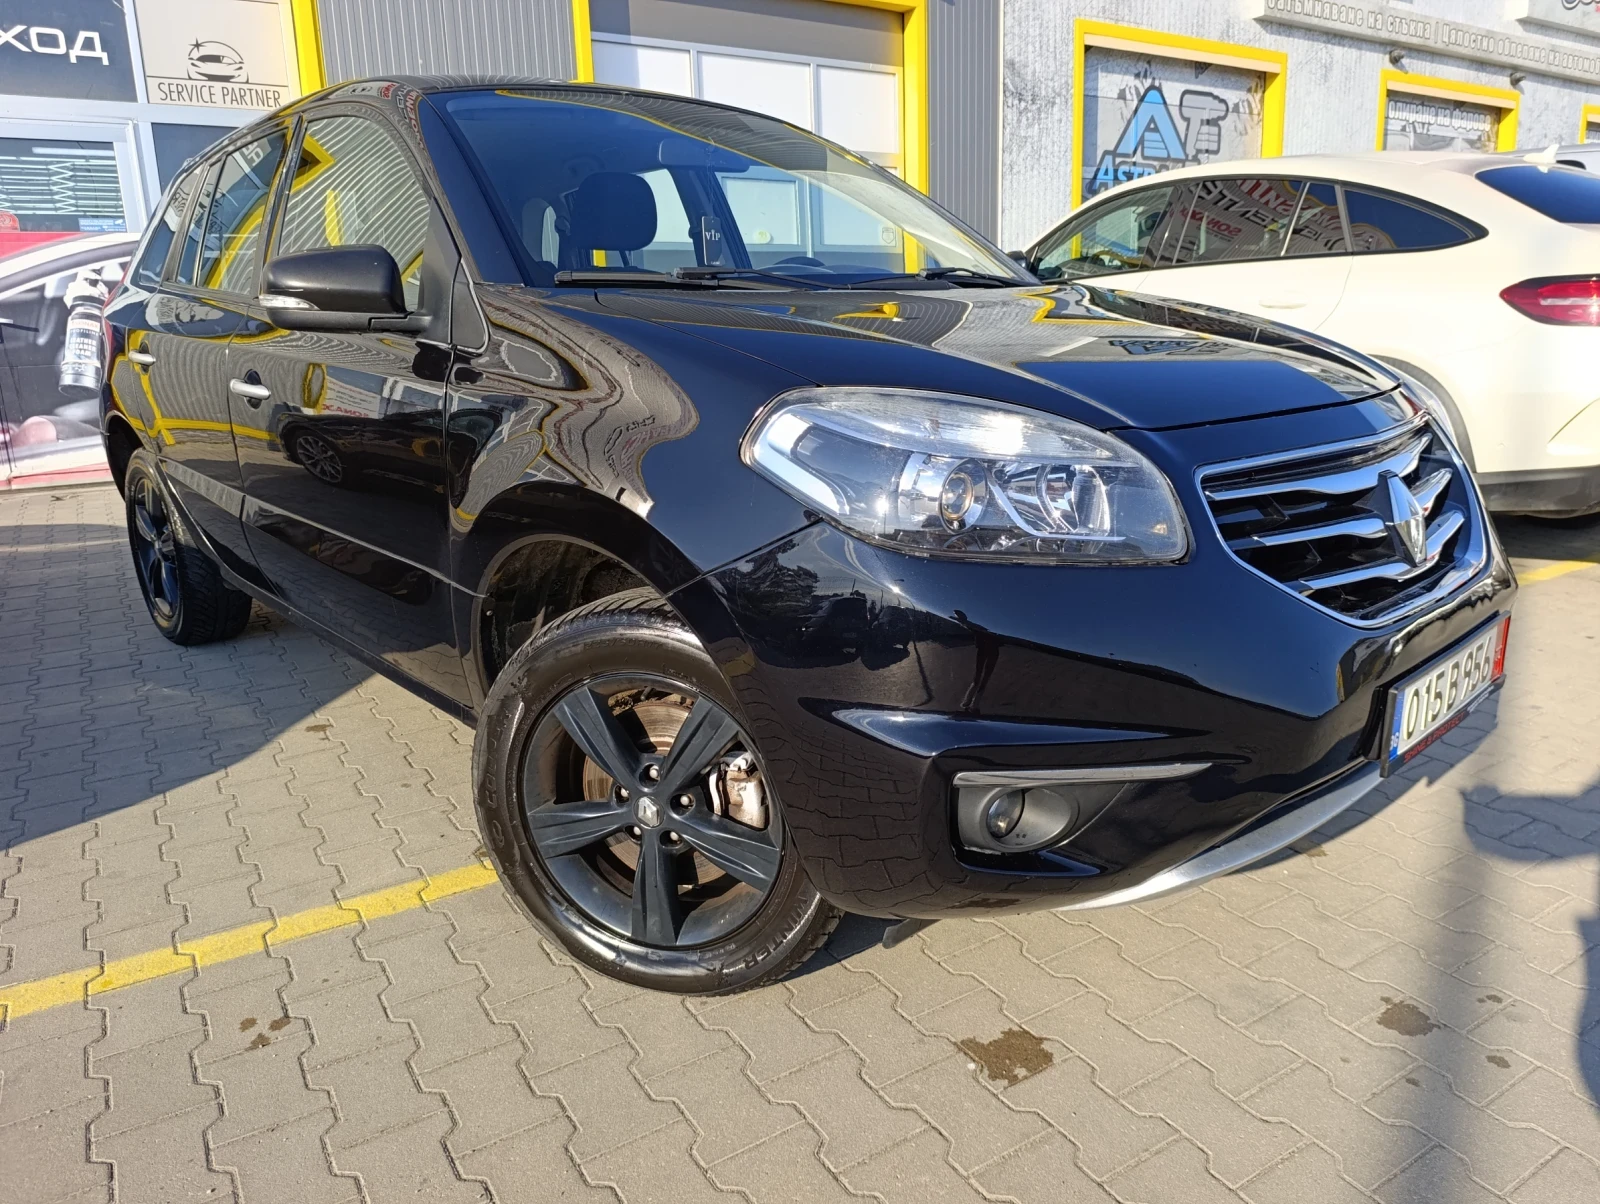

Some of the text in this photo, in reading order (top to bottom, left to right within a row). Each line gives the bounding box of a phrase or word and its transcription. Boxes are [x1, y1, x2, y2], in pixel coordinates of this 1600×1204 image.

[1366, 10, 1383, 31] на
[1387, 12, 1431, 40] стъкла
[1441, 23, 1496, 53] Цялостно
[1498, 37, 1547, 64] облепяне
[1548, 49, 1560, 67] на
[157, 82, 282, 108] SERVICE PARTNER
[1385, 100, 1436, 124] олиране
[1437, 106, 1451, 127] на
